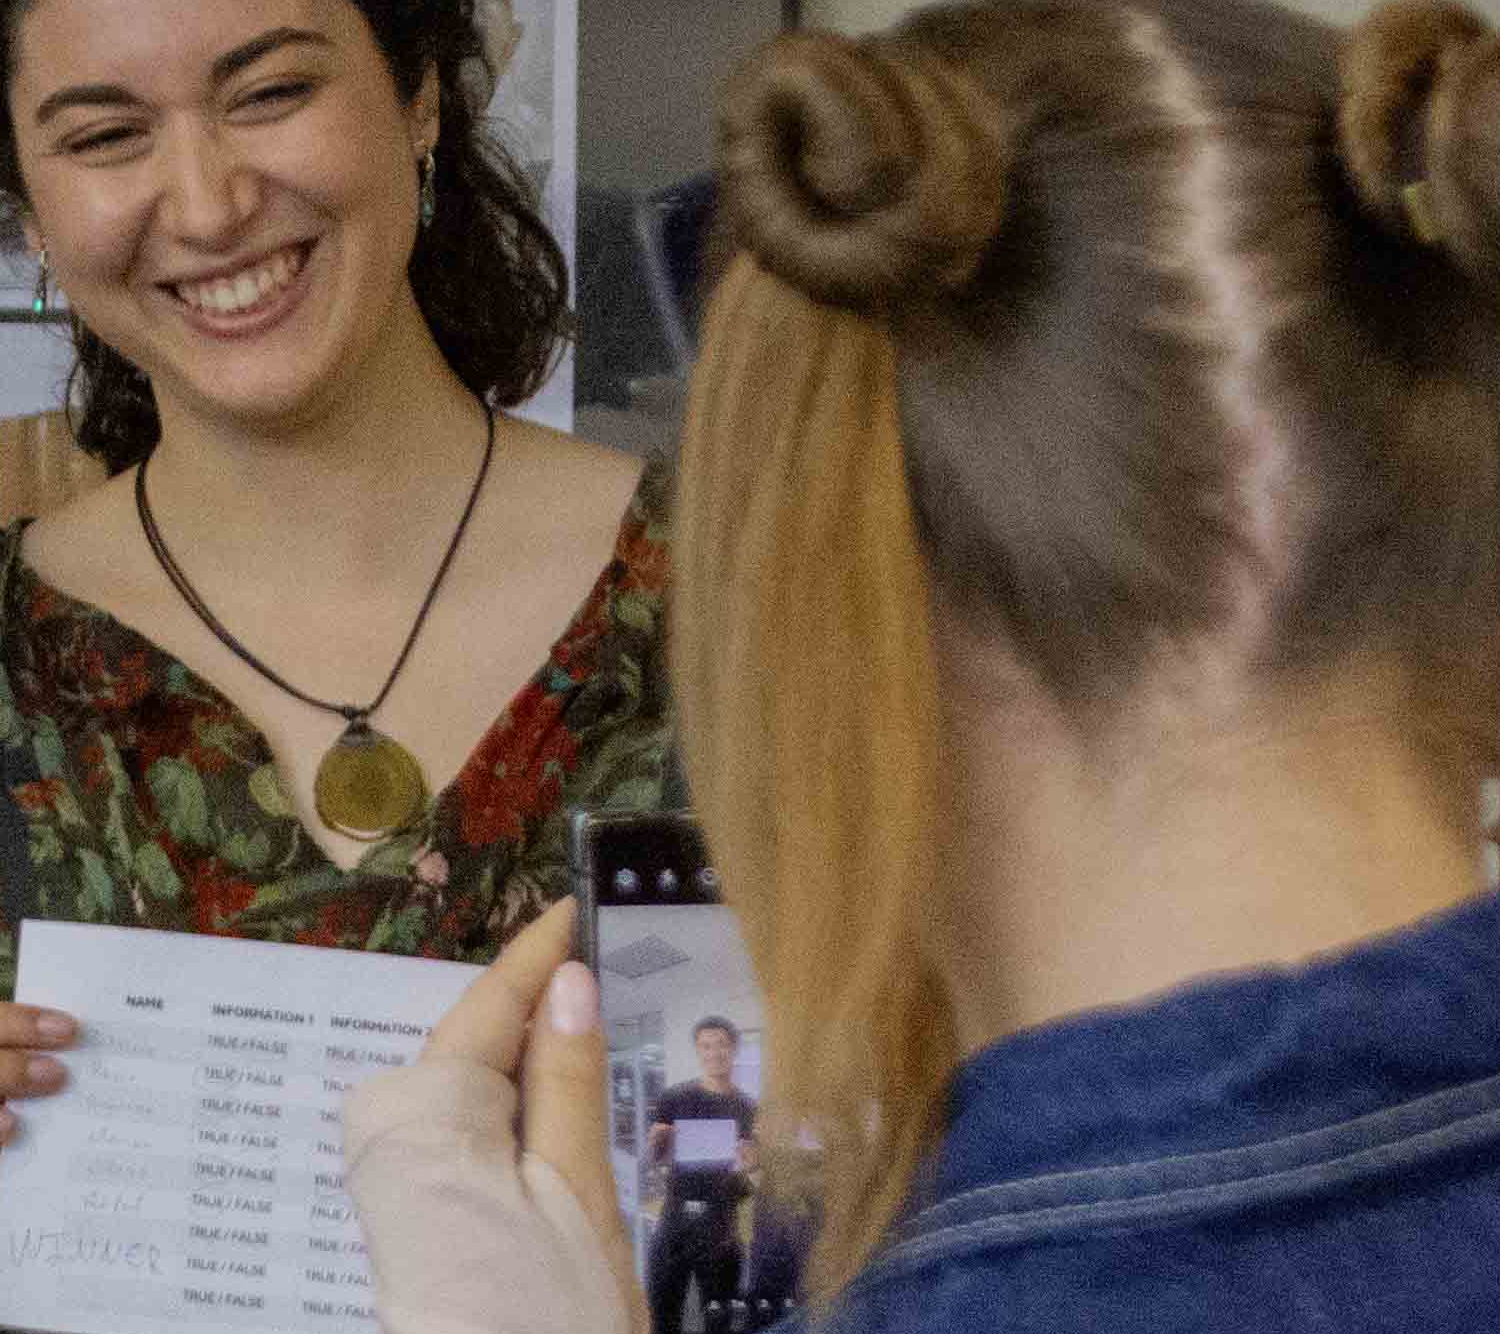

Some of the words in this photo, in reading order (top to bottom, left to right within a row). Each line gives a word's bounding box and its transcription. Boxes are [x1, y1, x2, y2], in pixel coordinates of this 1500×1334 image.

[126, 995, 164, 1009] NAME
[211, 1003, 305, 1024] INFORMATION
[330, 1016, 424, 1036] INFORMATION
